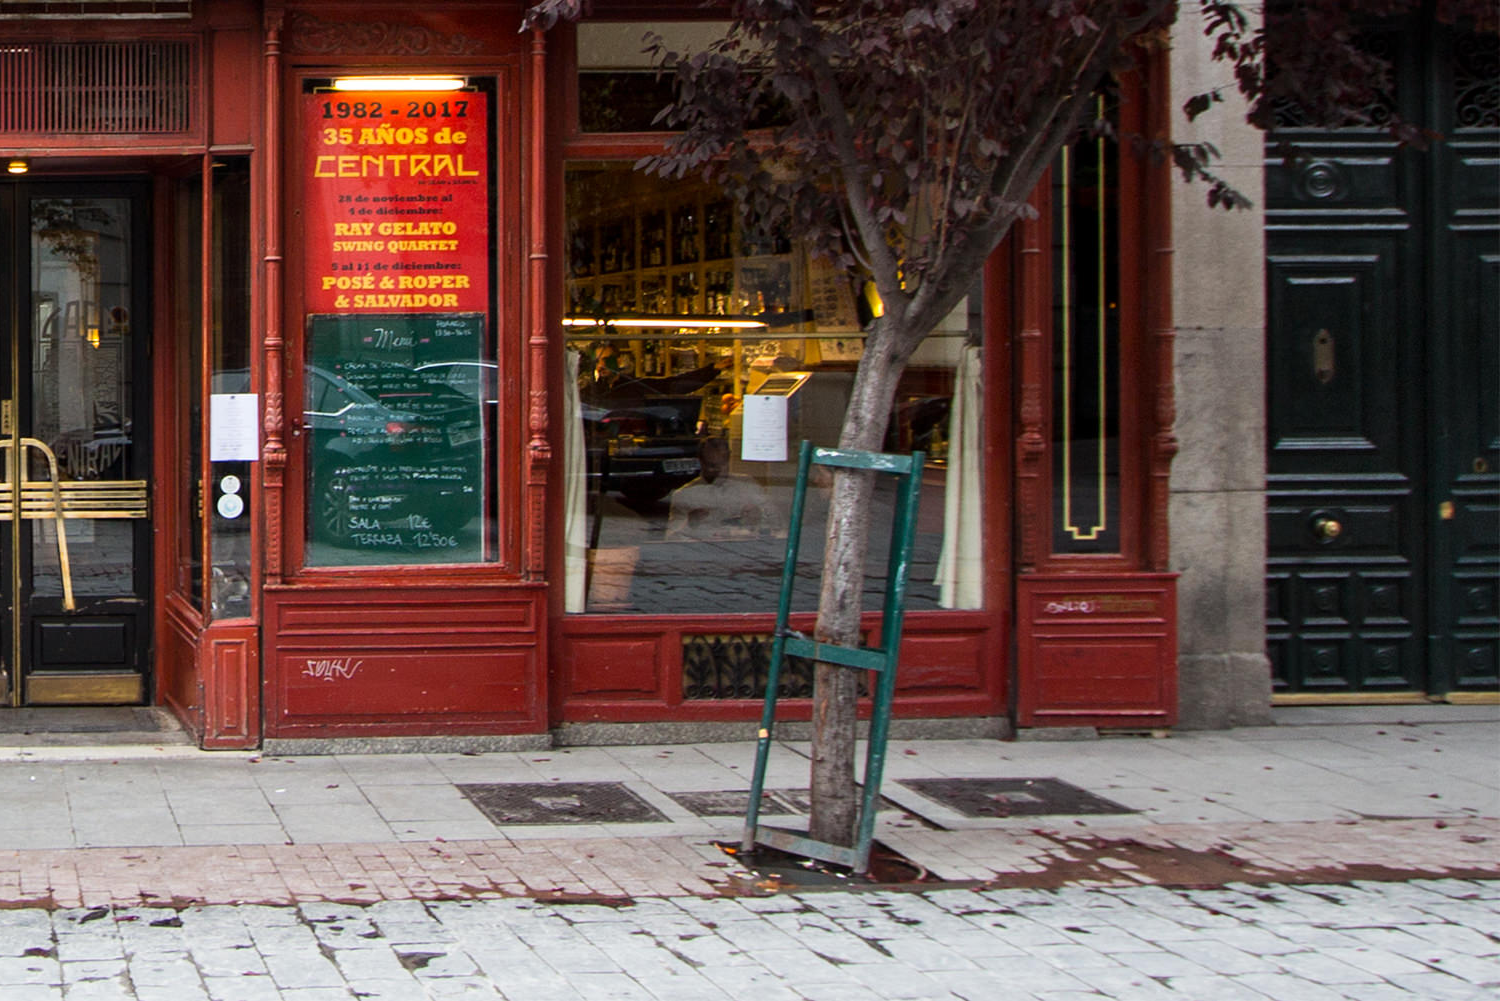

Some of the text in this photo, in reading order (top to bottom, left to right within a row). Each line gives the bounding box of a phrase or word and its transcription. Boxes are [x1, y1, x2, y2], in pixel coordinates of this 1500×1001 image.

[322, 101, 383, 119] 1982
[406, 101, 469, 119] 2017
[323, 123, 468, 146] 35 AÑOS de
[313, 154, 480, 178] CENTRAL
[355, 194, 369, 203] de
[372, 194, 439, 203] noviembre
[442, 194, 453, 203] al
[358, 207, 373, 216] de
[334, 222, 457, 237] RAY GELATO
[333, 240, 459, 254] SWING QUARTET
[373, 262, 389, 271] de
[321, 272, 470, 290] POSÉ & ROPER
[334, 293, 459, 309] & SALVADOR
[348, 517, 381, 530] SALA
